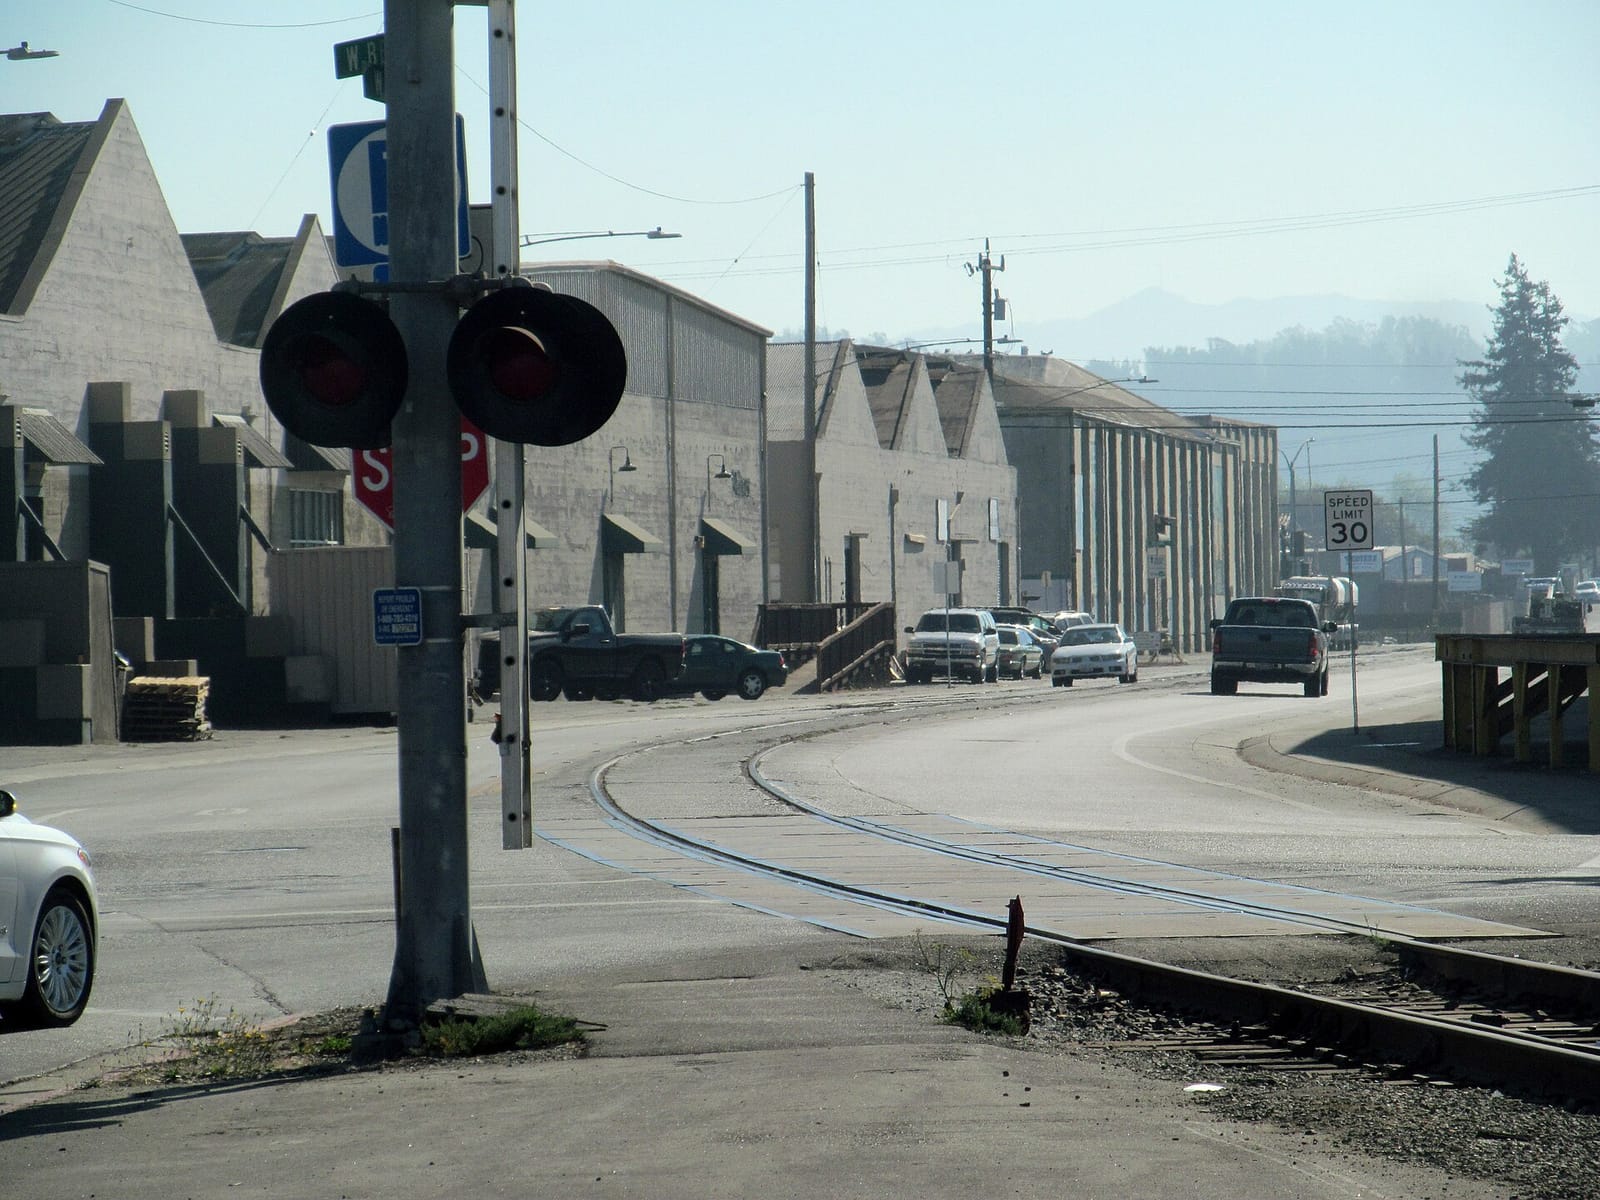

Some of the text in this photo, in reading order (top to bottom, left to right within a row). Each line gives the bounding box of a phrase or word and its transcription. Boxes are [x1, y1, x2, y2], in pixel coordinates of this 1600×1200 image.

[346, 45, 358, 72] W
[361, 431, 479, 492] SP
[1329, 497, 1369, 508] SPEED
[1333, 510, 1365, 520] LIMIT
[1331, 522, 1368, 544] 30
